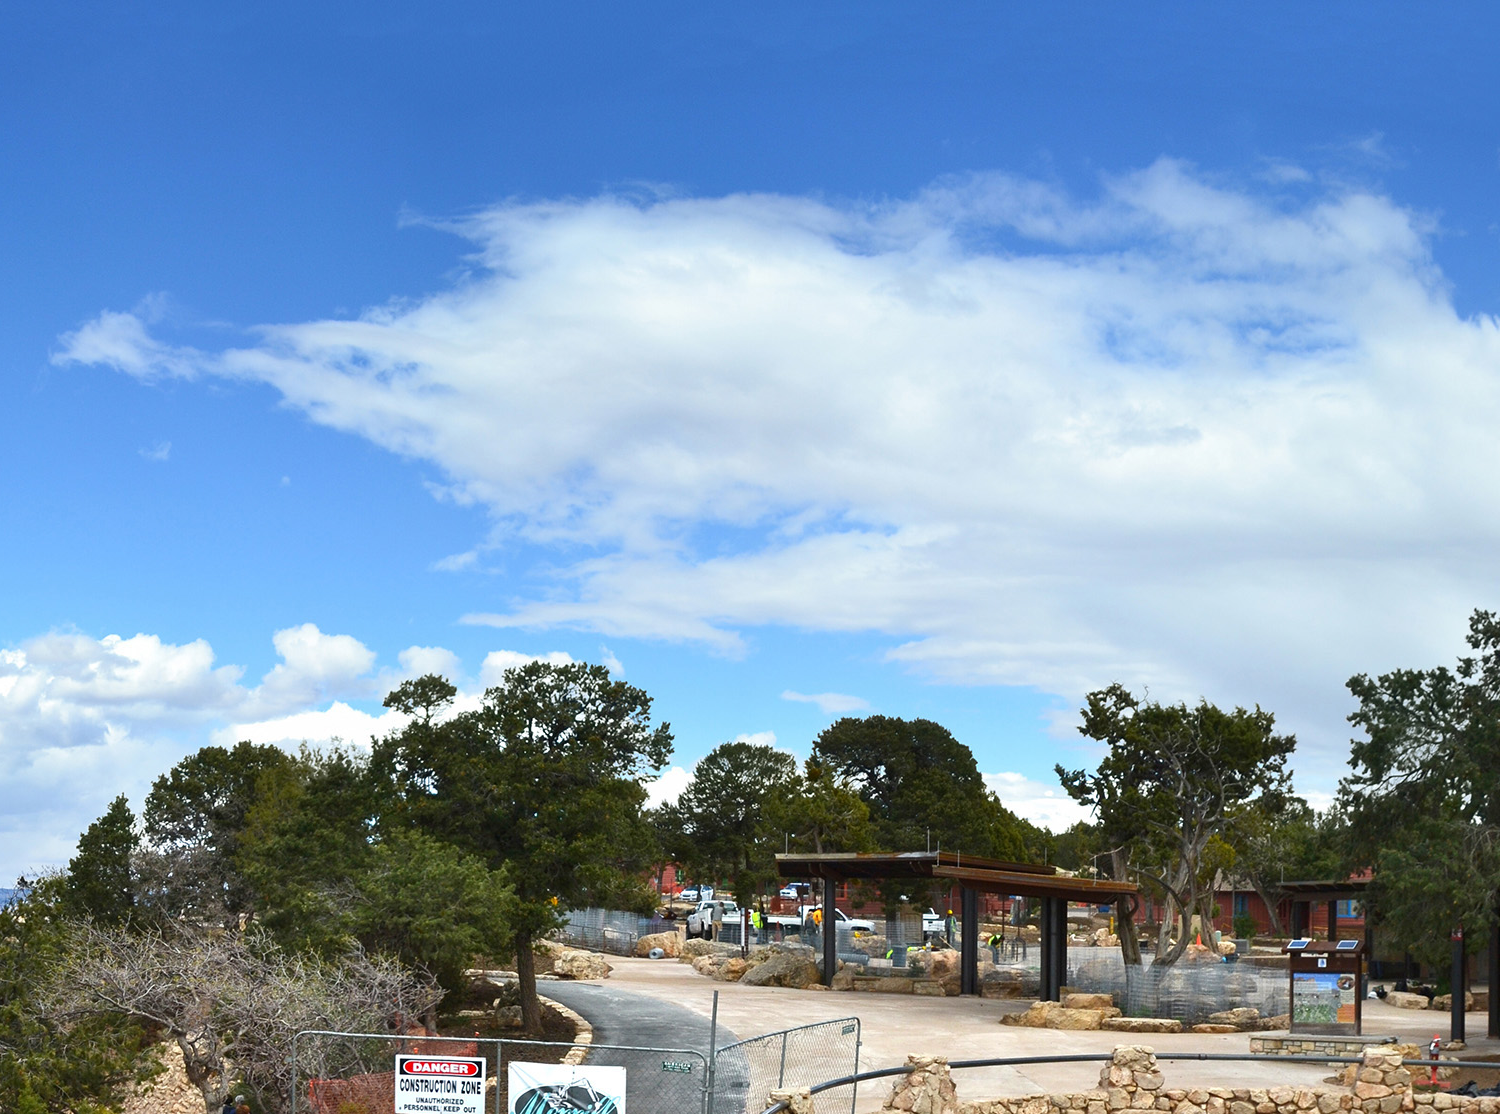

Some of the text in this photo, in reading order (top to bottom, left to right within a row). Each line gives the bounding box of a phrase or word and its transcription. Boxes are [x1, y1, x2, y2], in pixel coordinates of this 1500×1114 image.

[412, 1062, 469, 1073] DANGER
[400, 1078, 481, 1095] CONSTRUCTION ZONE
[415, 1097, 464, 1105] UNAUTHORIZED
[403, 1104, 440, 1112] PERSONNEL
